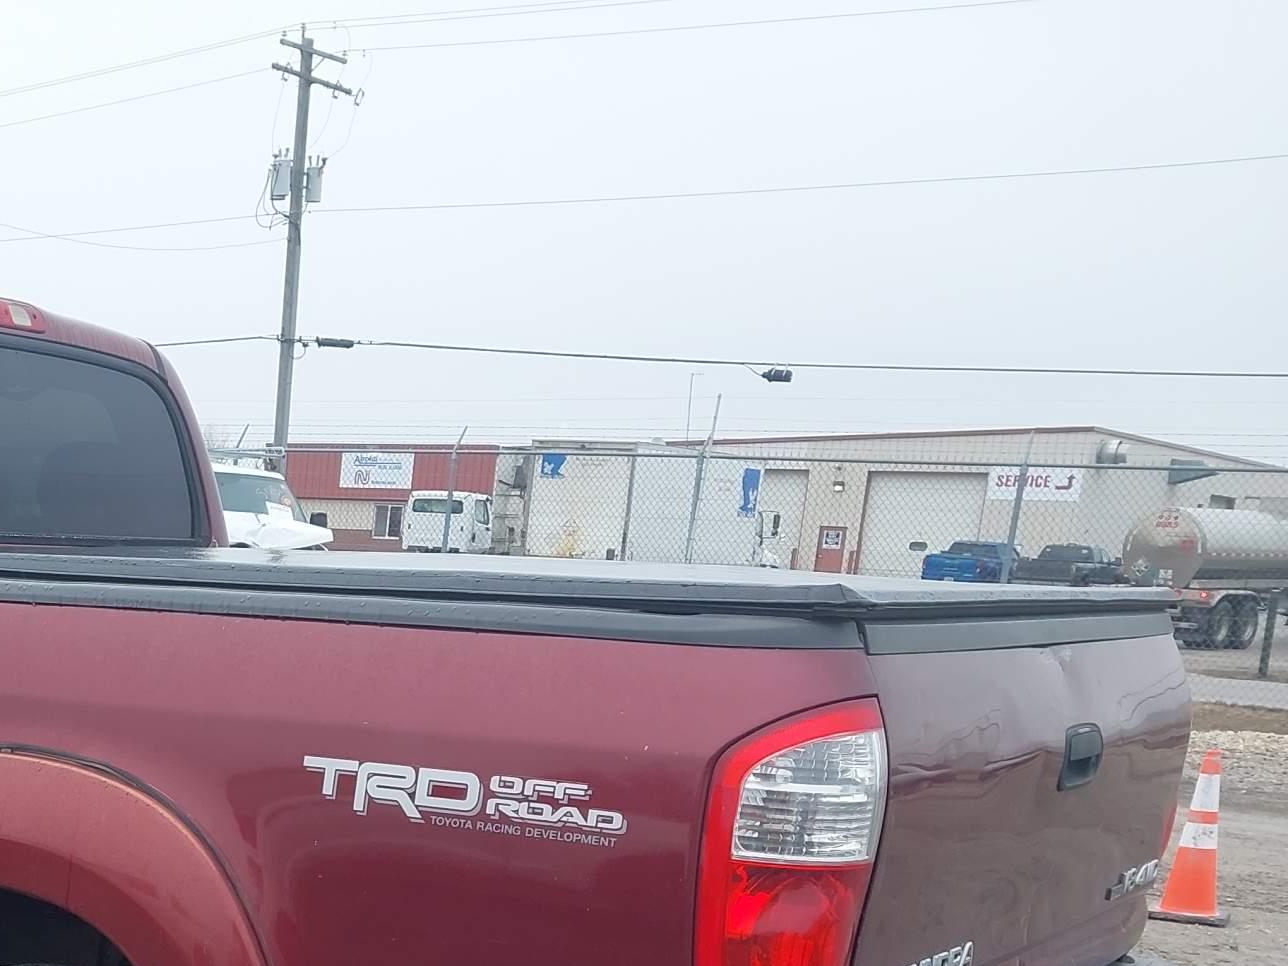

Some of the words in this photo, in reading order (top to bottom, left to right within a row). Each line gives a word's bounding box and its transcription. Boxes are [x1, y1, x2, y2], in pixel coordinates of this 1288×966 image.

[303, 755, 483, 823] TRD
[488, 775, 593, 803] OFF
[430, 815, 473, 831] TOYOTA
[476, 820, 521, 836] RACING
[524, 827, 617, 848] DEVELOPMENT
[486, 798, 628, 835] ROAD
